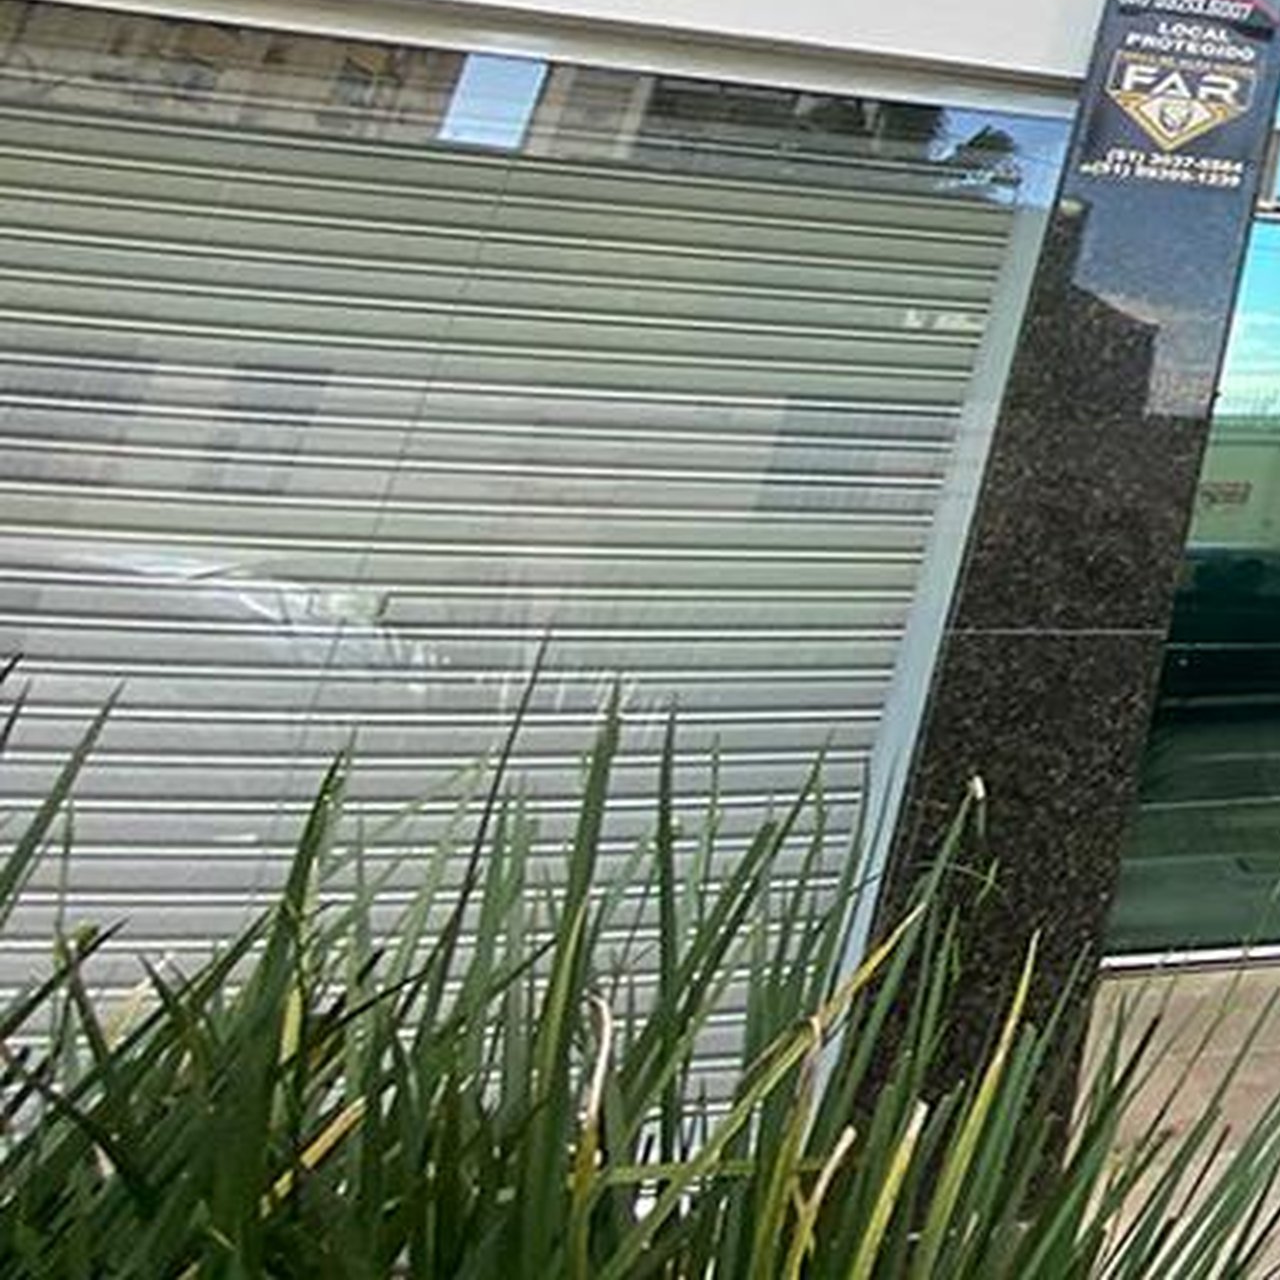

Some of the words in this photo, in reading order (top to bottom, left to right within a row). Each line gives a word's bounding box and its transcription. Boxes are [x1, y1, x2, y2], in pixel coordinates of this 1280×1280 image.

[1126, 31, 1256, 61] PROTEGIDO
[1157, 21, 1230, 42] LOCAL
[1122, 63, 1240, 106] FAR
